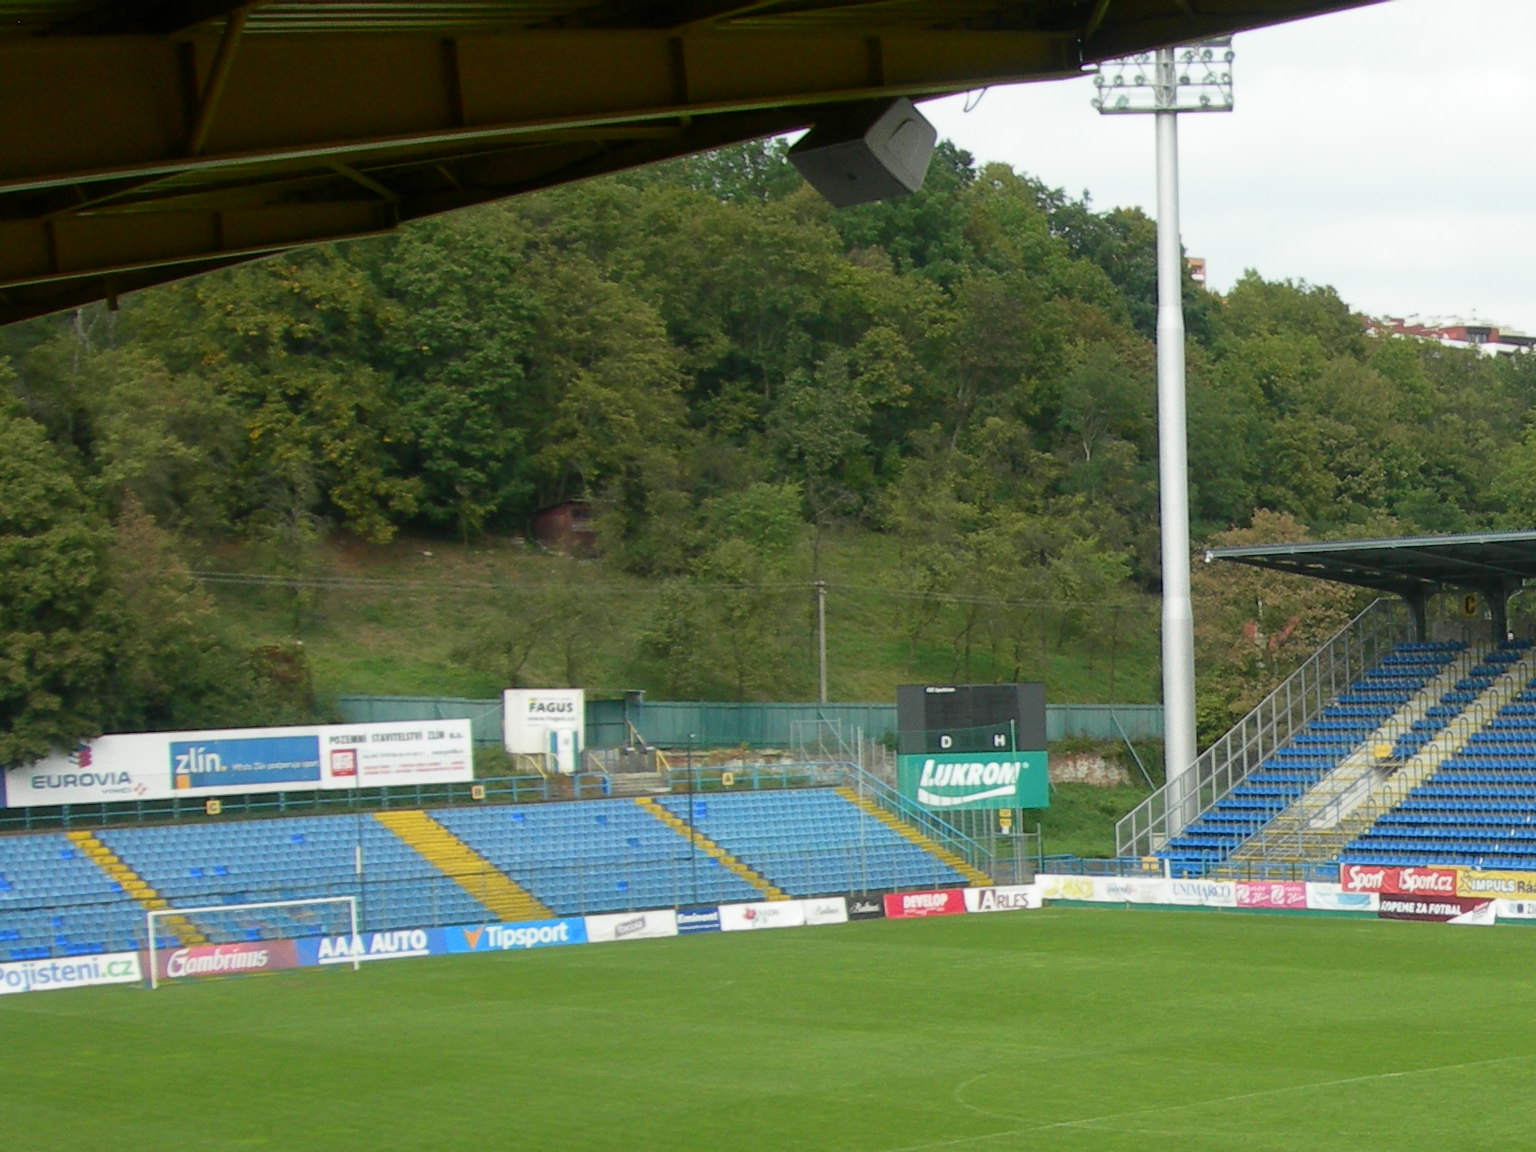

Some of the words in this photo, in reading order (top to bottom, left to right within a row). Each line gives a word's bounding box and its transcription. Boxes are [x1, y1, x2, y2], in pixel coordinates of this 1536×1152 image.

[1465, 596, 1475, 614] C
[529, 702, 573, 712] FAGUS
[941, 735, 952, 748] D
[994, 734, 1005, 747] H
[31, 771, 132, 789] EUROVIA
[920, 759, 1020, 787] LUKROM
[1348, 866, 1385, 891] Sport
[1470, 879, 1516, 893] IMPULS
[903, 893, 948, 909] DEVELOP
[979, 889, 1029, 909] ARLES
[1416, 903, 1428, 915] ZA
[318, 934, 365, 958] AAA
[370, 930, 427, 952] AUTO
[485, 922, 568, 949] Tipsport
[167, 948, 268, 978] Gambrinus
